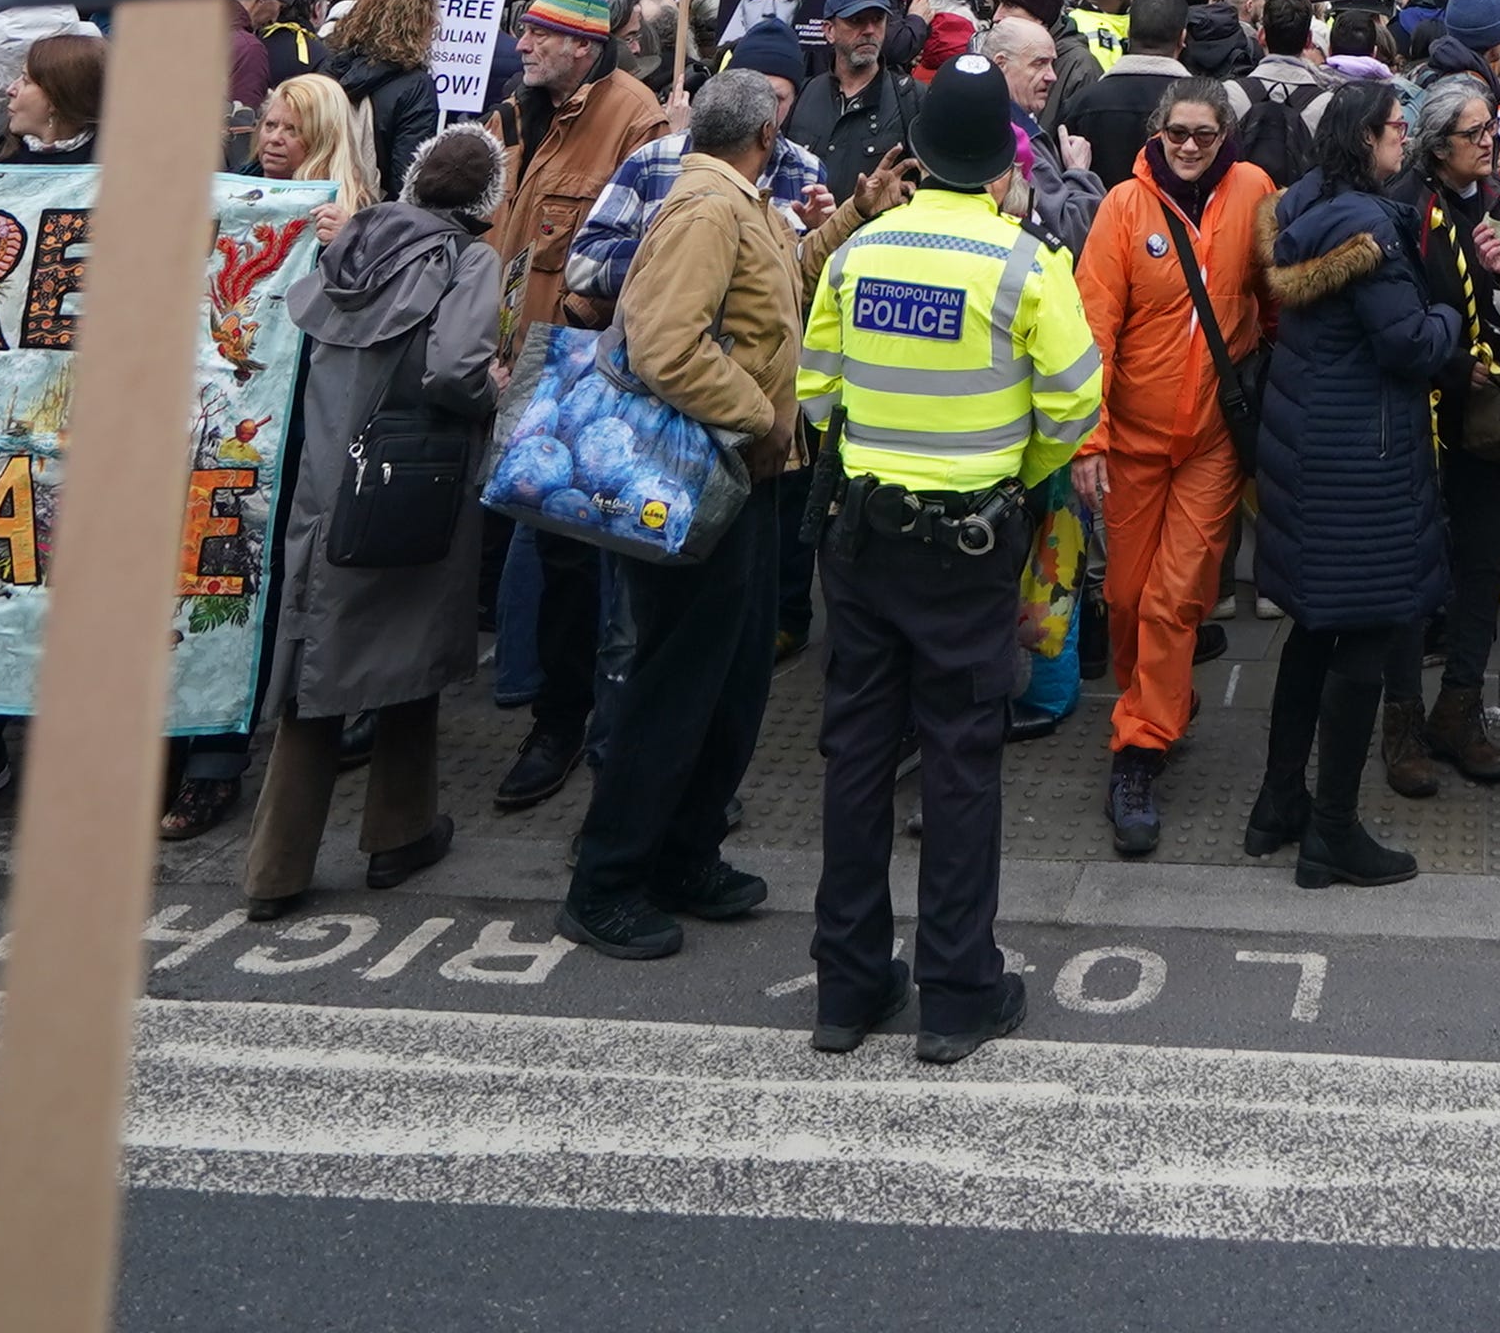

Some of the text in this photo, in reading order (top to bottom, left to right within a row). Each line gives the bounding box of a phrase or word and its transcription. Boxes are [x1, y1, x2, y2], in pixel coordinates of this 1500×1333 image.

[435, 74, 481, 96] OW!
[860, 281, 960, 306] METROPOLITAN
[857, 298, 957, 335] POLICE
